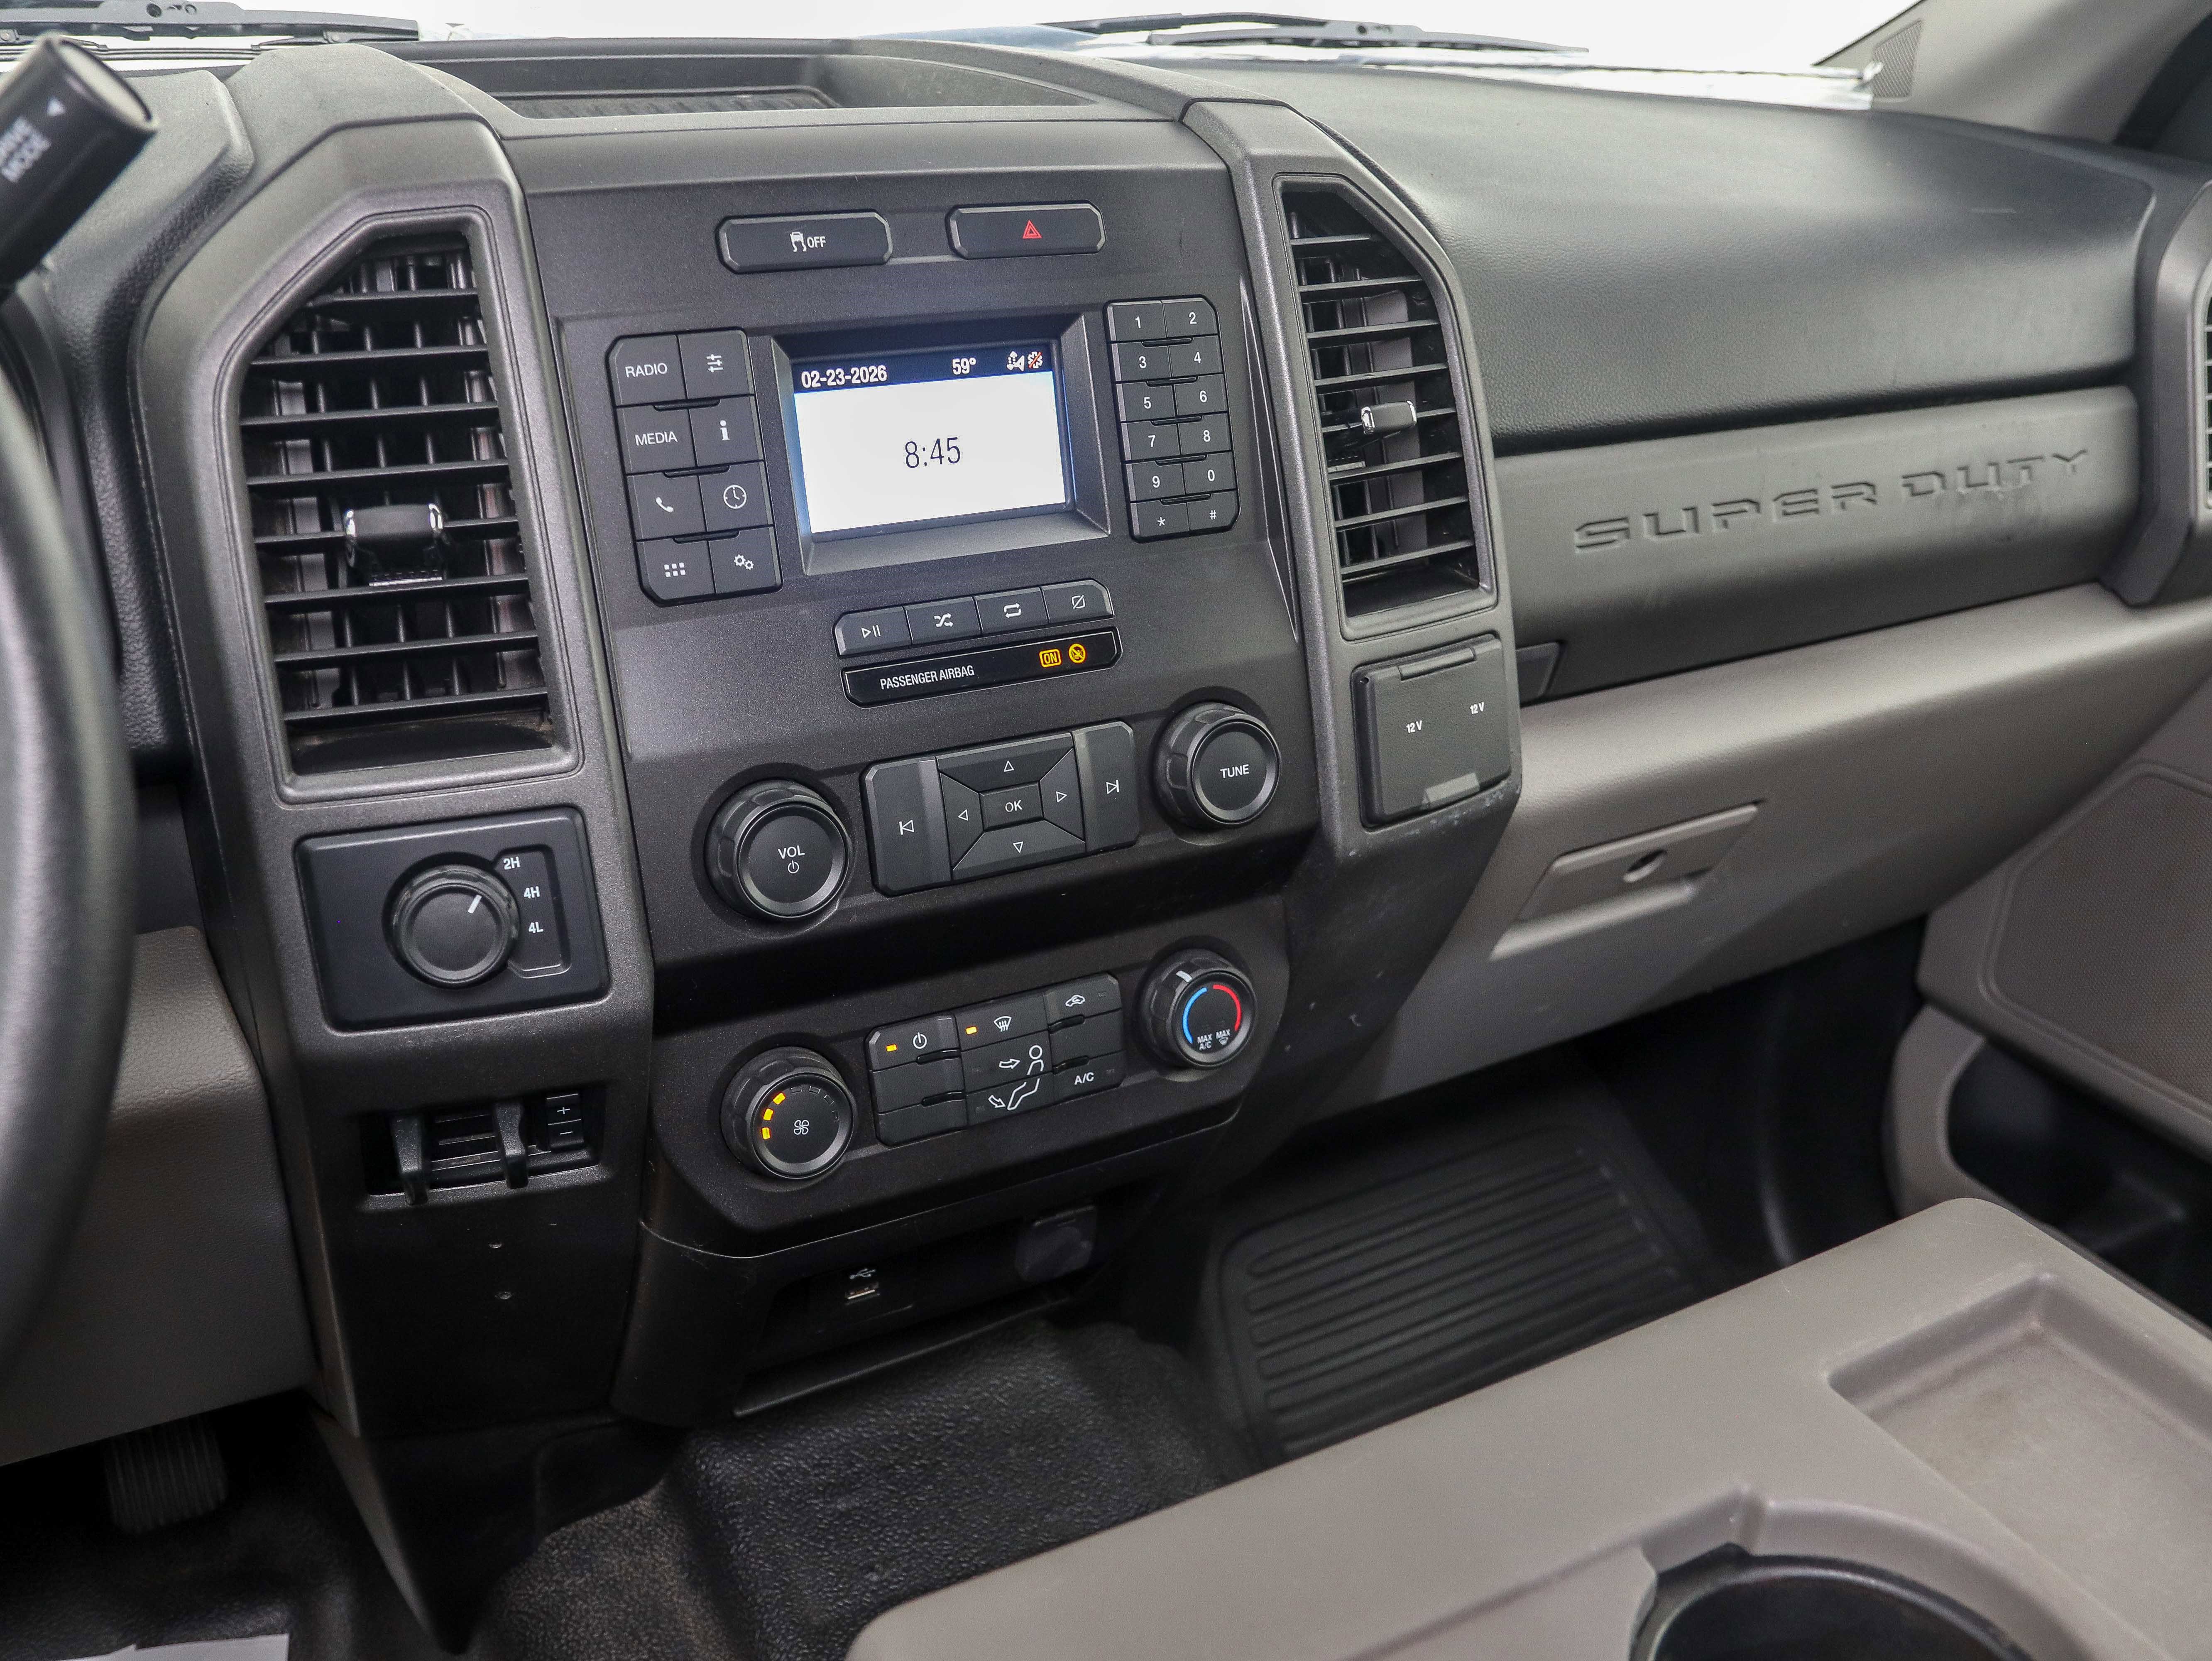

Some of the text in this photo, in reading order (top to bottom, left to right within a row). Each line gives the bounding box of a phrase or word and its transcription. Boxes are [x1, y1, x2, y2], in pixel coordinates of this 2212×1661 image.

[807, 236, 826, 248] OFF
[1135, 316, 1141, 328] 1
[1189, 312, 1197, 324] 2
[1139, 356, 1147, 368] 3
[1194, 351, 1201, 364] 4
[625, 363, 668, 378] RADIO
[801, 365, 887, 388] 02-23-2026
[1199, 390, 1207, 402] 6
[1144, 397, 1151, 409] 5
[635, 431, 678, 446] MEDIA
[1148, 435, 1155, 447] 7
[1203, 430, 1211, 442] 8
[905, 437, 961, 468] 8:45
[1152, 475, 1160, 488] 9
[1207, 469, 1215, 482] 0
[1574, 448, 2087, 553] SUPER DUTY
[1044, 652, 1057, 664] ON
[880, 665, 975, 689] PASSENGER AIRBAG
[1220, 764, 1250, 779] TUNE
[1005, 800, 1023, 812] OK
[778, 845, 805, 860] VOL
[503, 856, 520, 870] 2H
[524, 886, 540, 899] 4H
[528, 921, 544, 933] 4L
[1197, 1034, 1213, 1044] MAX
[1216, 1029, 1231, 1039] MAX
[1199, 1041, 1212, 1051] A/C
[1074, 1072, 1094, 1085] A/C
